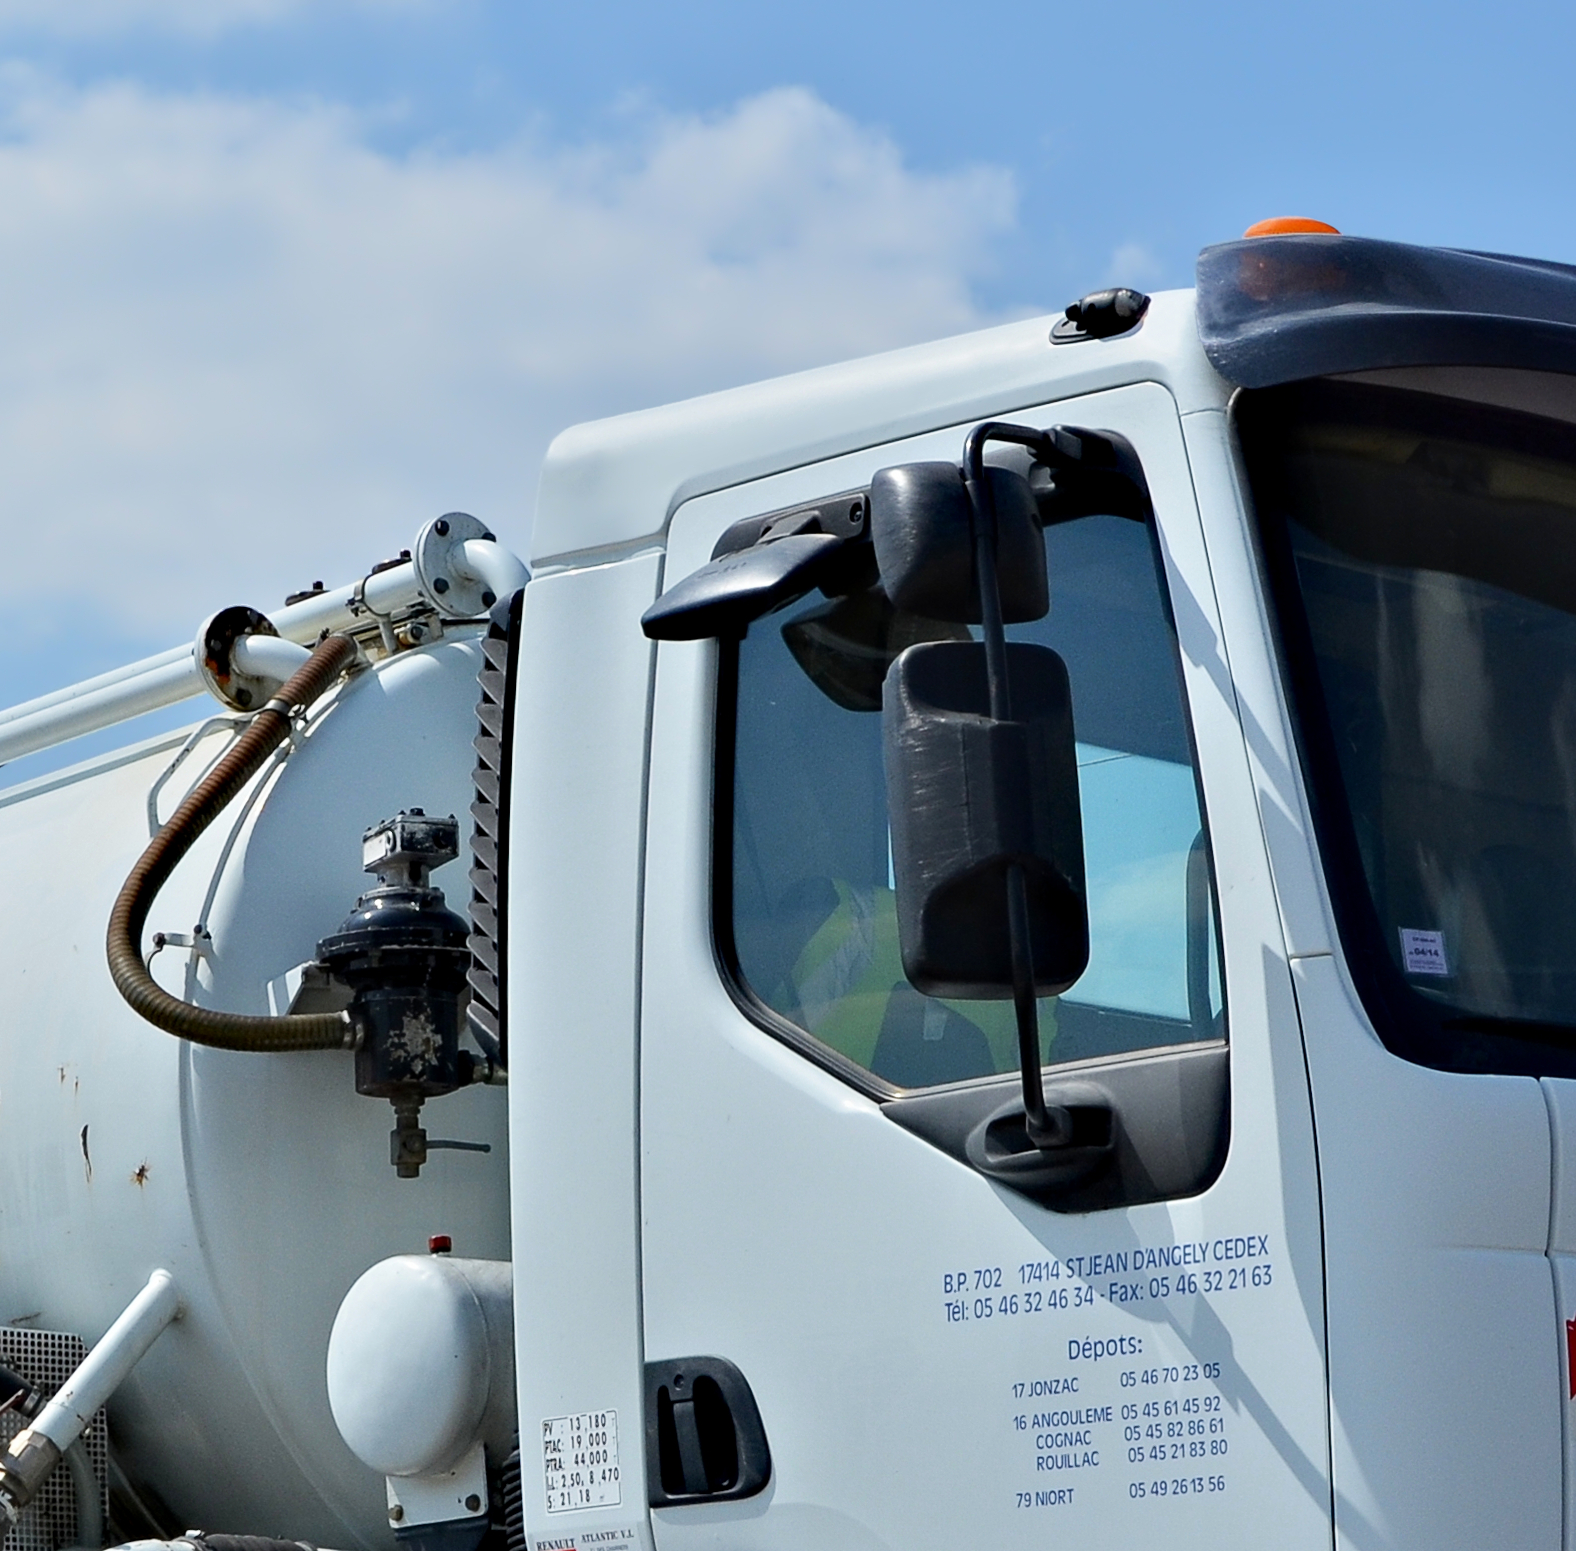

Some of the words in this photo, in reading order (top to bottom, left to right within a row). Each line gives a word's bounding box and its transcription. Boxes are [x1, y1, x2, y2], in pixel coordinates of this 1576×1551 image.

[943, 1273, 969, 1294] B.P.
[974, 1268, 1002, 1290] 702
[1018, 1261, 1060, 1284] 17414
[1133, 1243, 1209, 1271] D'ANGELY
[1213, 1235, 1268, 1261] CEDEX
[945, 1299, 969, 1322] Tél:
[974, 1298, 993, 1319] 05
[999, 1294, 1018, 1315] 46
[1024, 1292, 1042, 1313] 32
[1048, 1289, 1068, 1310] 46
[1074, 1285, 1094, 1307] 34
[1109, 1282, 1144, 1302] Fax:
[1149, 1278, 1169, 1298] 05
[1176, 1275, 1197, 1295] 46
[1204, 1272, 1222, 1292] 32
[1228, 1268, 1246, 1289] 21
[1251, 1265, 1272, 1286] 63
[1068, 1335, 1143, 1361] Dépots:
[1012, 1384, 1025, 1398] 17
[1028, 1378, 1079, 1398] JONZAC
[1121, 1373, 1136, 1387] 05
[1141, 1370, 1159, 1385] 46
[1163, 1368, 1178, 1383] 70
[1183, 1365, 1199, 1381] 23
[1203, 1363, 1220, 1378] 05
[1013, 1416, 1027, 1430] 16
[1031, 1407, 1113, 1429] ANGOULEME
[1122, 1405, 1137, 1420] 05
[1142, 1402, 1159, 1418] 45
[1164, 1401, 1178, 1415] 61
[1183, 1398, 1199, 1413] 45
[1204, 1396, 1221, 1411] 92
[1036, 1431, 1092, 1449] COGNAC
[1124, 1426, 1140, 1441] 05
[1145, 1424, 1162, 1439] 45
[1167, 1422, 1184, 1437] 82
[1188, 1420, 1205, 1435] 86
[1209, 1418, 1224, 1433] 61
[1036, 1451, 1099, 1471] ROUILLAC
[1128, 1448, 1144, 1462] 05
[1149, 1445, 1166, 1460] 45
[1171, 1443, 1185, 1458] 21
[1189, 1442, 1206, 1457] 83
[1210, 1440, 1227, 1455] 80
[1016, 1493, 1031, 1508] 79
[1036, 1488, 1074, 1506] NIORT
[1129, 1483, 1145, 1498] 05
[1151, 1481, 1167, 1496] 49
[1172, 1480, 1188, 1495] 26
[1192, 1478, 1204, 1493] 13
[1209, 1476, 1225, 1491] 56
[537, 1538, 574, 1551] RENAULT
[581, 1531, 618, 1544] ATLANTIC
